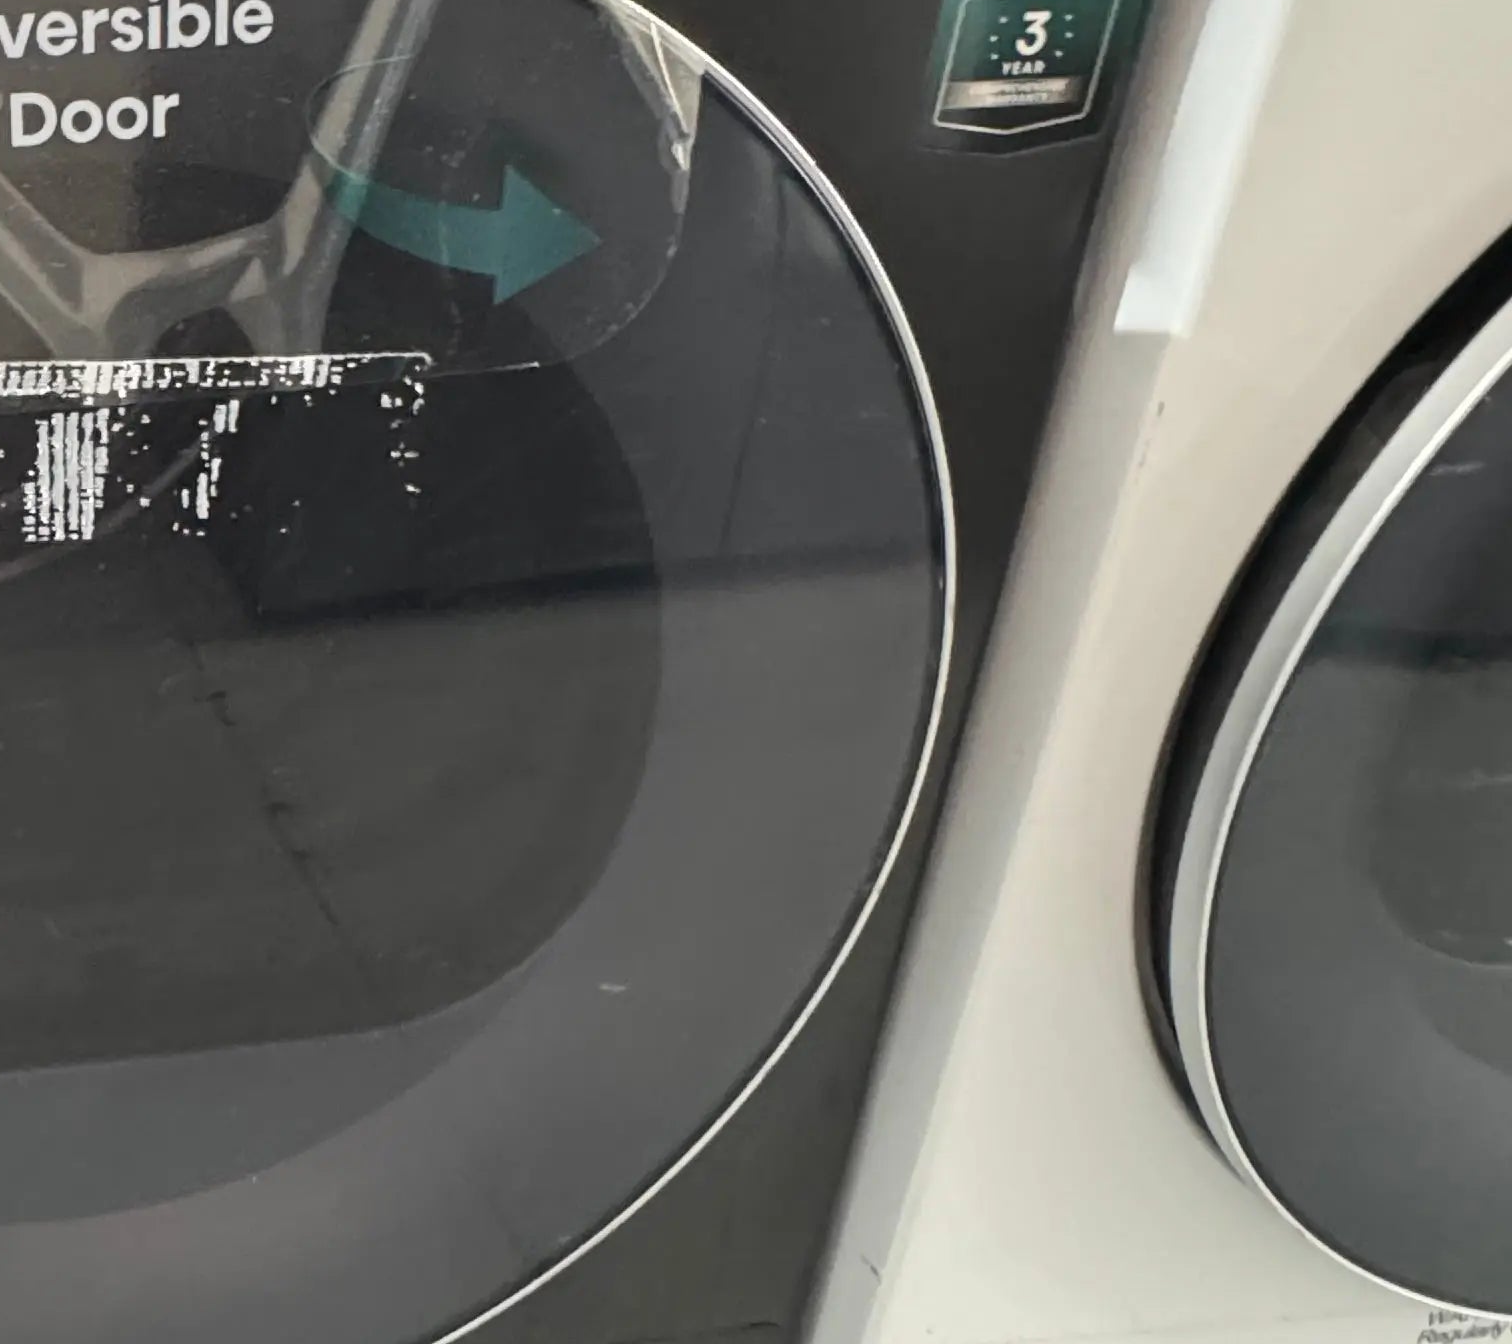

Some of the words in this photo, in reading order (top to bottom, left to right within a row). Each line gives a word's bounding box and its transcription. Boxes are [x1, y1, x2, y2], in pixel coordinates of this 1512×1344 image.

[1015, 10, 1053, 57] 3
[1001, 60, 1046, 75] YEAR
[9, 91, 180, 148] Door
